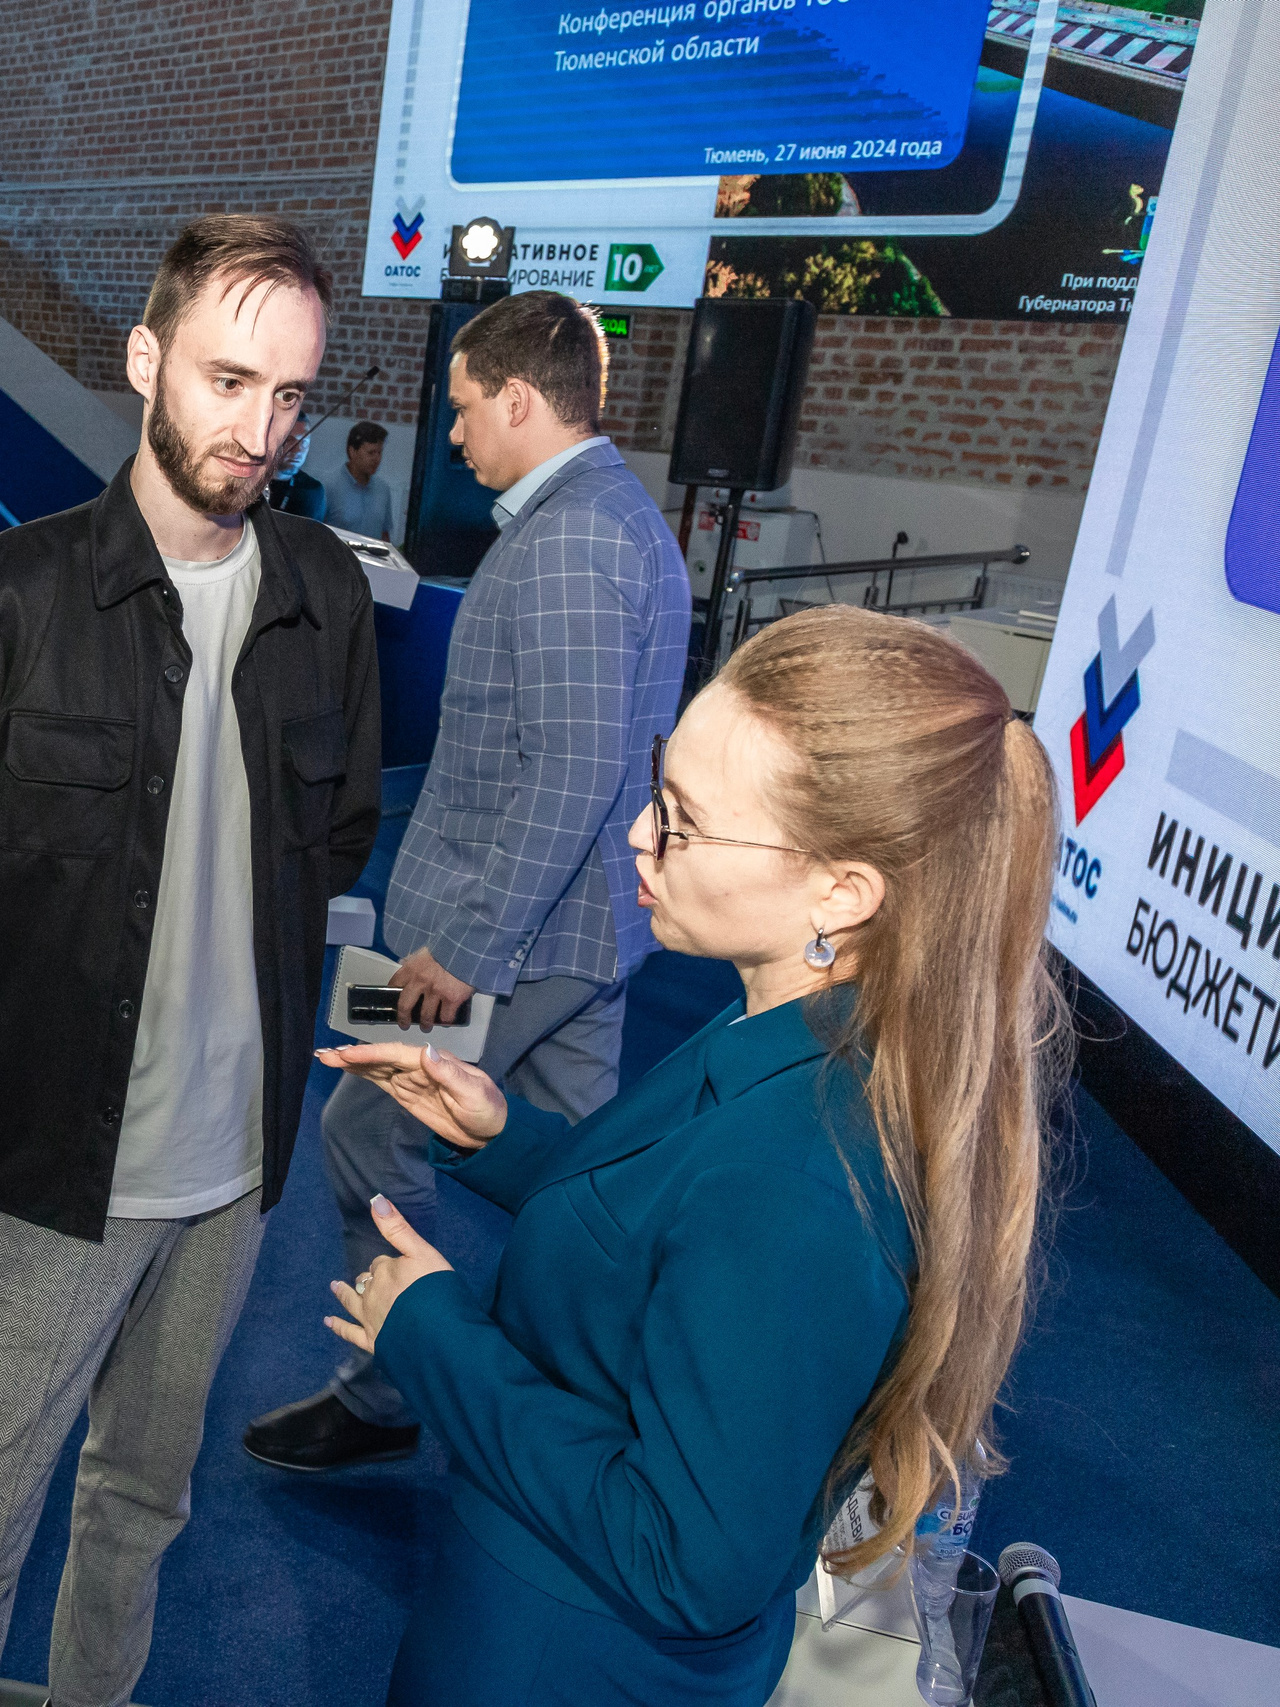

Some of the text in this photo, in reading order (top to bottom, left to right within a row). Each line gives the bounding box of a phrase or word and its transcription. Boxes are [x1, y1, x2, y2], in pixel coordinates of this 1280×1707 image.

[558, 2, 696, 36] Конференция
[554, 35, 760, 72] Тюменской области
[704, 138, 942, 165] Тюмень, 27 июня 2024 года
[384, 264, 422, 278] ОАТОС
[612, 252, 643, 283] 10
[1061, 273, 1094, 290] При
[1018, 294, 1116, 314] Губернатора
[600, 317, 628, 335] ХОД
[1057, 832, 1102, 899] ТОС
